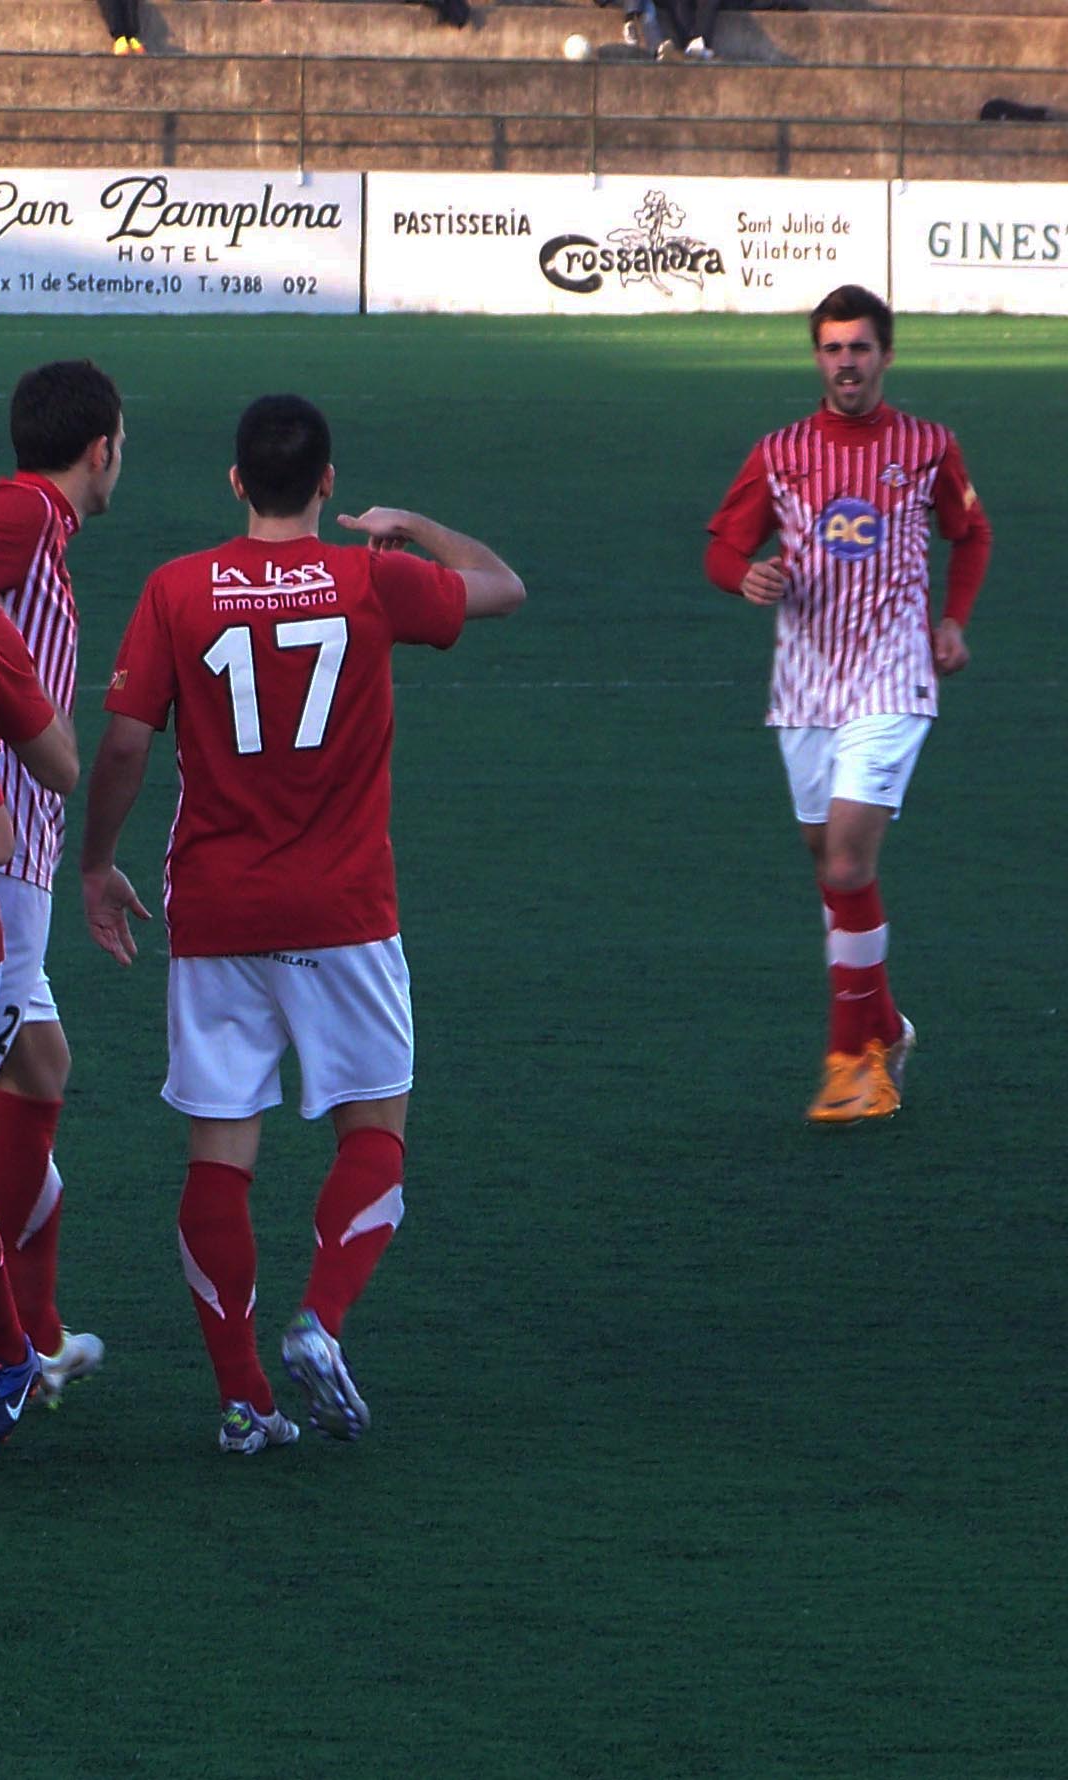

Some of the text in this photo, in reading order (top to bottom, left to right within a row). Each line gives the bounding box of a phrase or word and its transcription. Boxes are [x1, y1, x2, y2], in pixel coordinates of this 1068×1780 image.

[99, 175, 342, 247] Pamplona
[737, 211, 773, 234] Sant
[832, 214, 851, 234] de
[740, 240, 837, 260] Vilatorta
[928, 221, 1068, 261] GINES
[118, 245, 219, 263] HOTEL
[538, 234, 726, 294] Crossandra
[19, 272, 34, 292] 11
[41, 272, 62, 292] de
[220, 275, 263, 294] 9388
[283, 276, 318, 294] 092
[741, 266, 774, 287] Vic
[825, 513, 877, 545] AC
[203, 616, 349, 755] 17
[272, 952, 319, 969] RELATS
